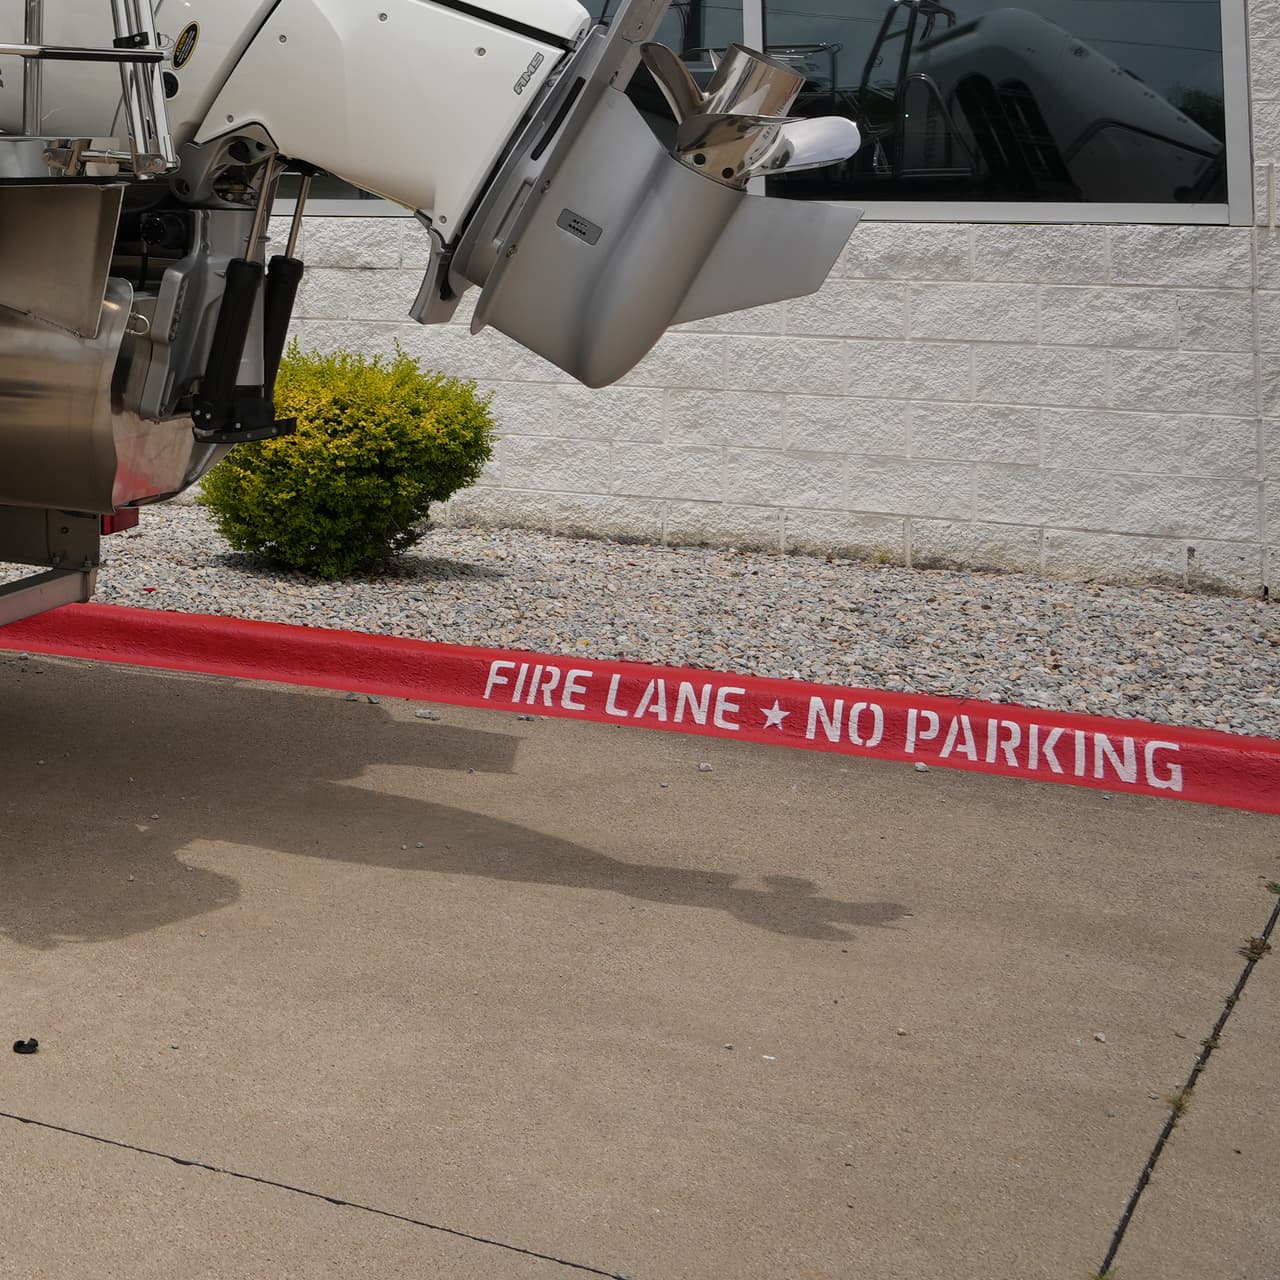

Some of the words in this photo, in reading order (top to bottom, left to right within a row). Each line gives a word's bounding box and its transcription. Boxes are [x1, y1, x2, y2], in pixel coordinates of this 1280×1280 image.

[482, 660, 594, 711] FIRE
[604, 673, 746, 731] LANE
[805, 695, 884, 748] NO
[904, 708, 1184, 793] PARKING
